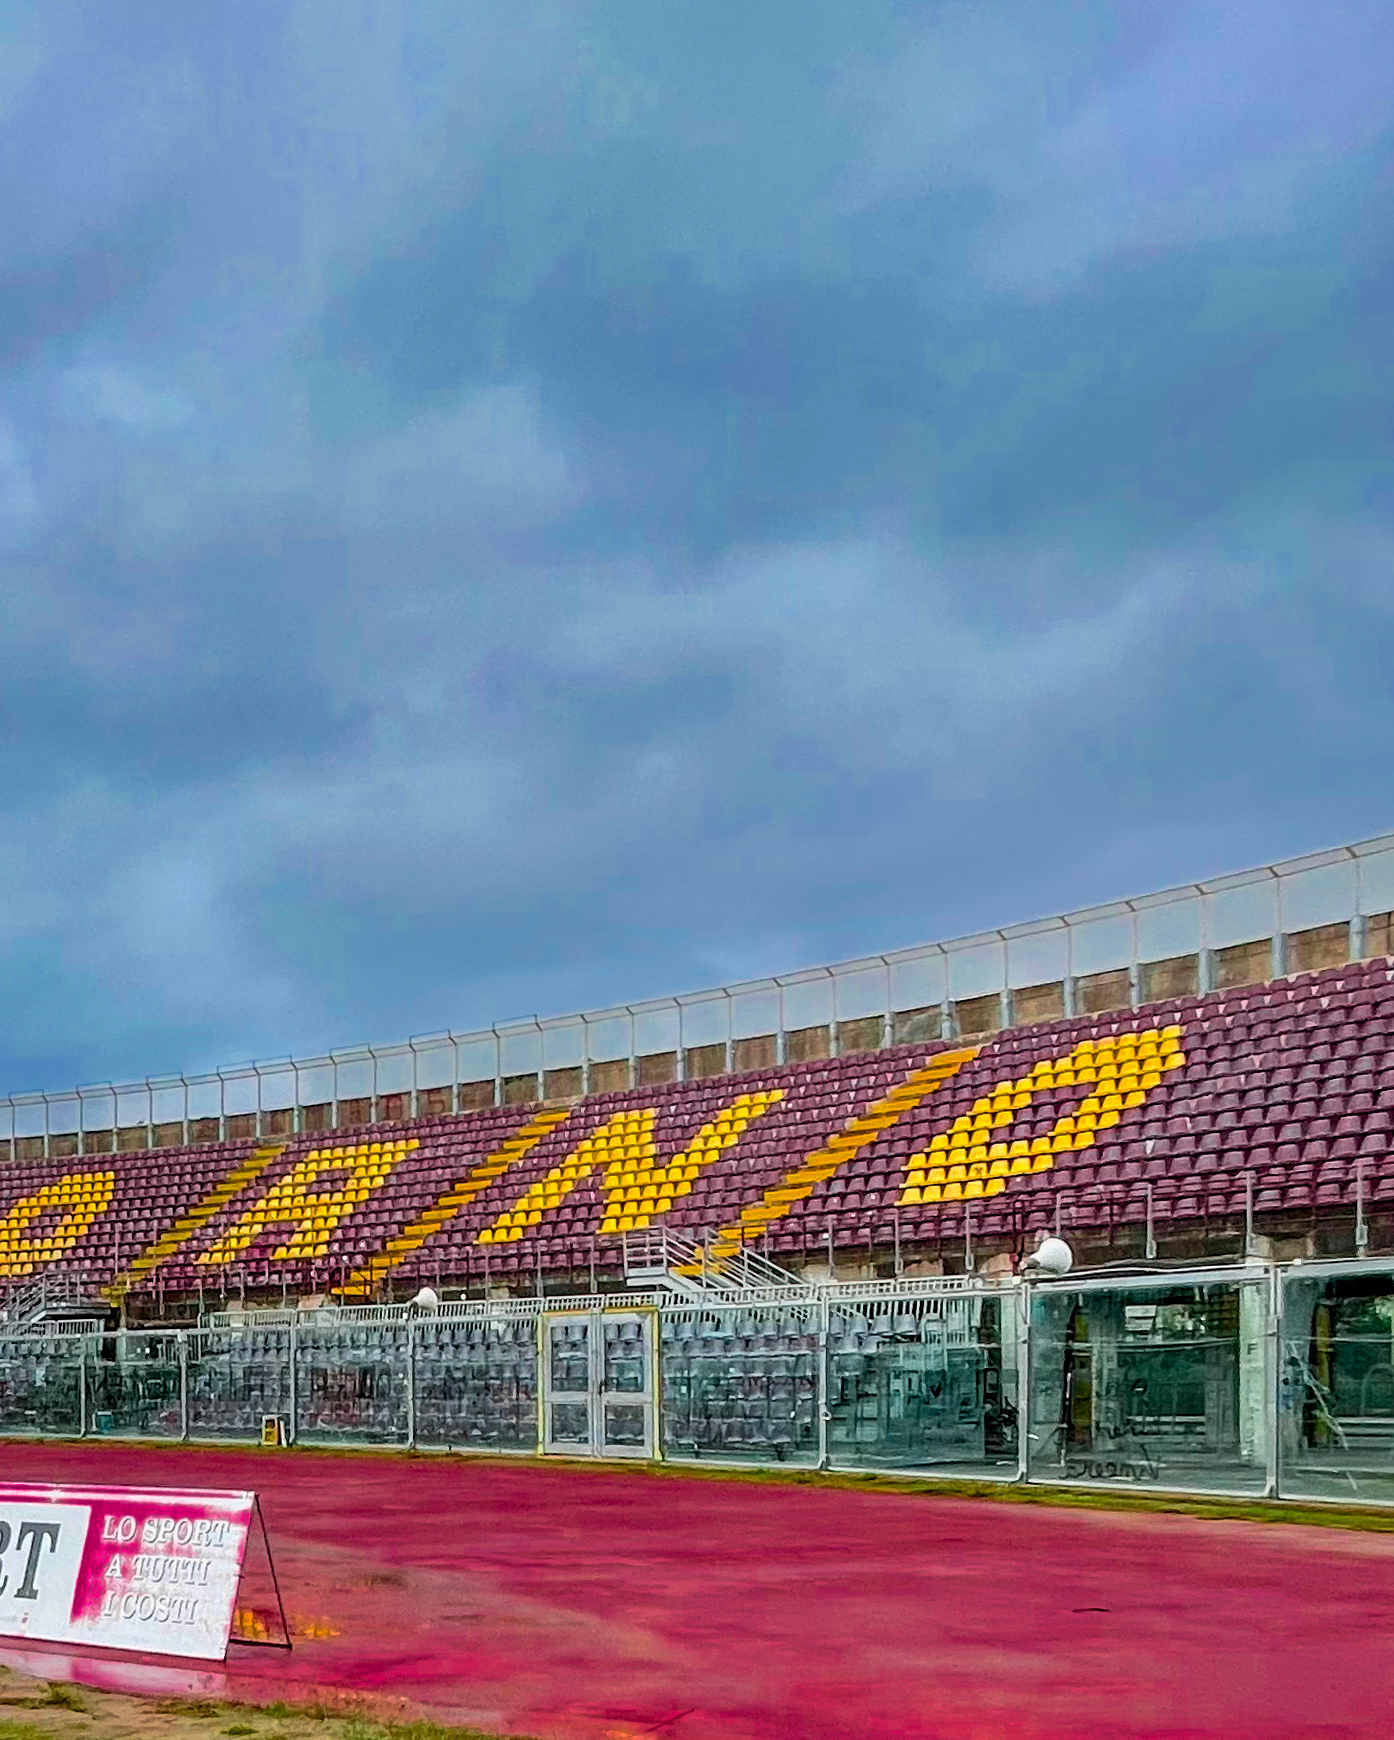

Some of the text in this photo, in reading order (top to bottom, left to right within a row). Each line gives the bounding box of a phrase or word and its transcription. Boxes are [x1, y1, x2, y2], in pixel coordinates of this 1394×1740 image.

[102, 1515, 230, 1547] LO SPORT
[106, 1553, 212, 1586] A TUTTI
[103, 1591, 199, 1625] I COSTI
